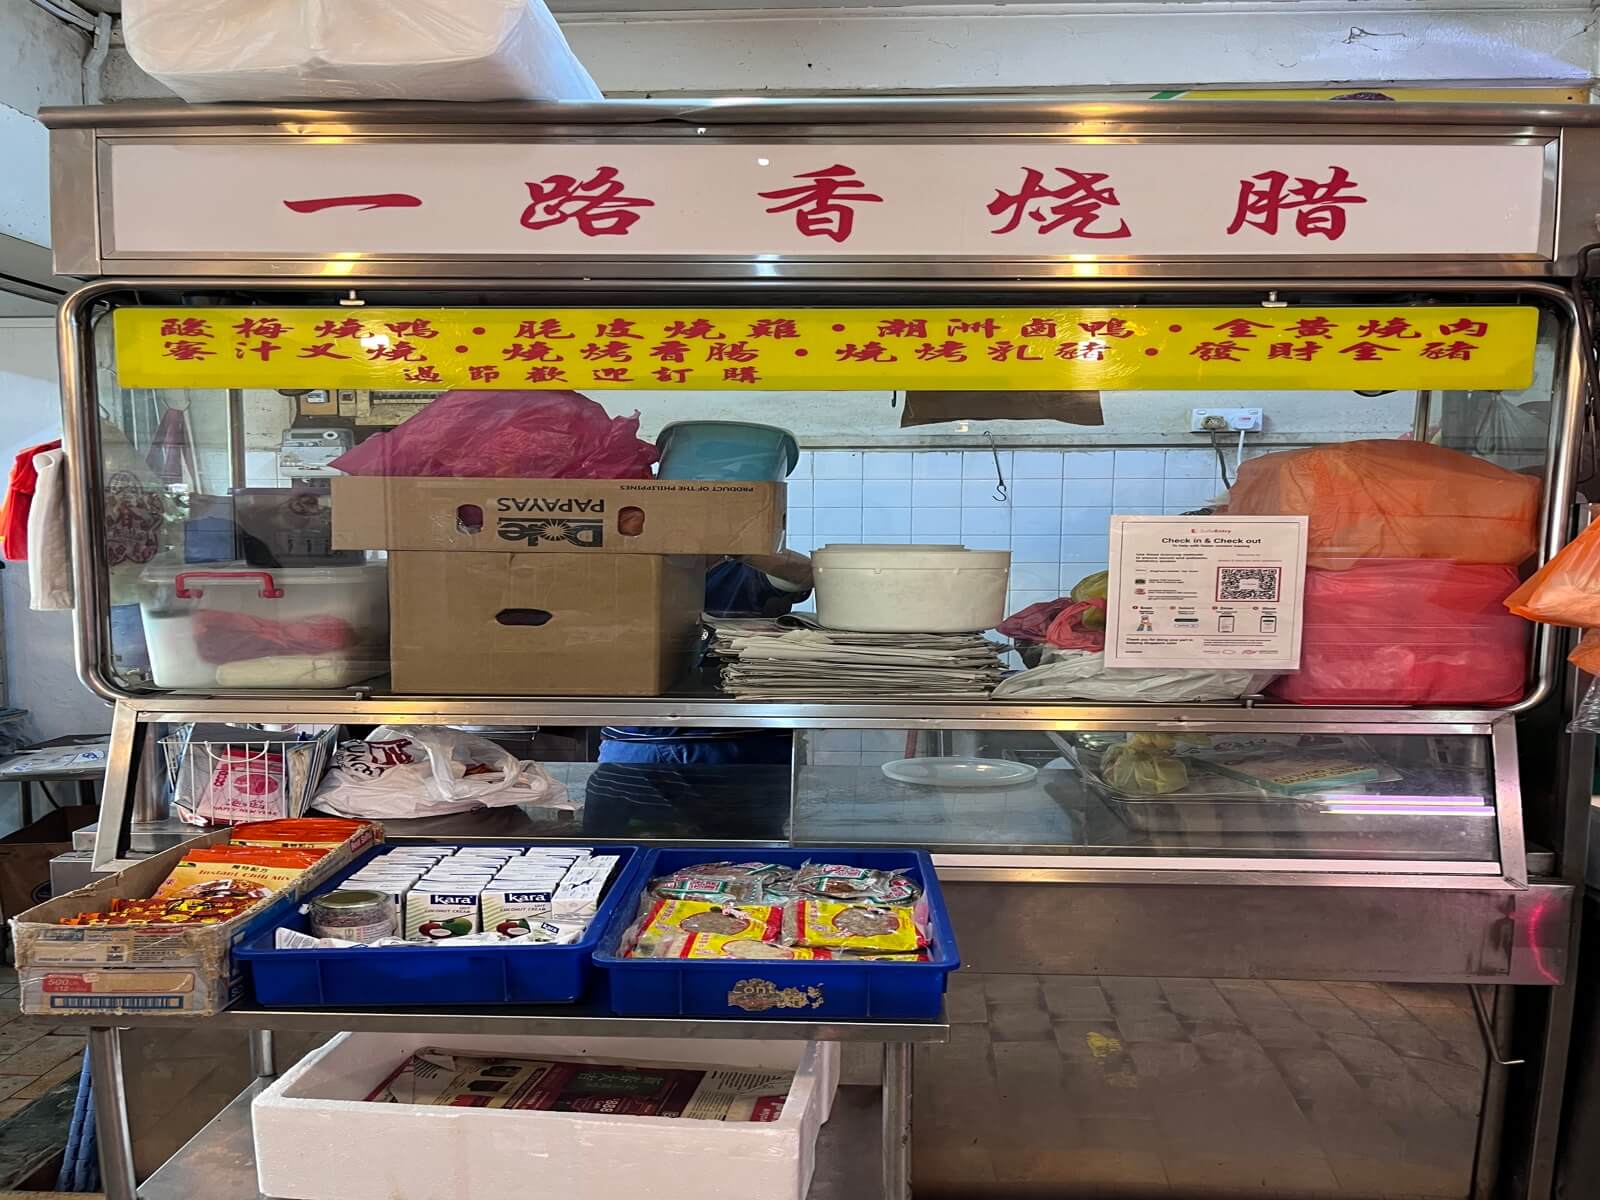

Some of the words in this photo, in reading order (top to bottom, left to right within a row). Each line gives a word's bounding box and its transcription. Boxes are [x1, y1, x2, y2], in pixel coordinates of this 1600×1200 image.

[284, 163, 1367, 242] 一路香烧腊
[497, 497, 605, 513] PAPAYAS
[496, 517, 604, 548] Dole
[434, 894, 472, 905] kara
[508, 893, 546, 903] kara
